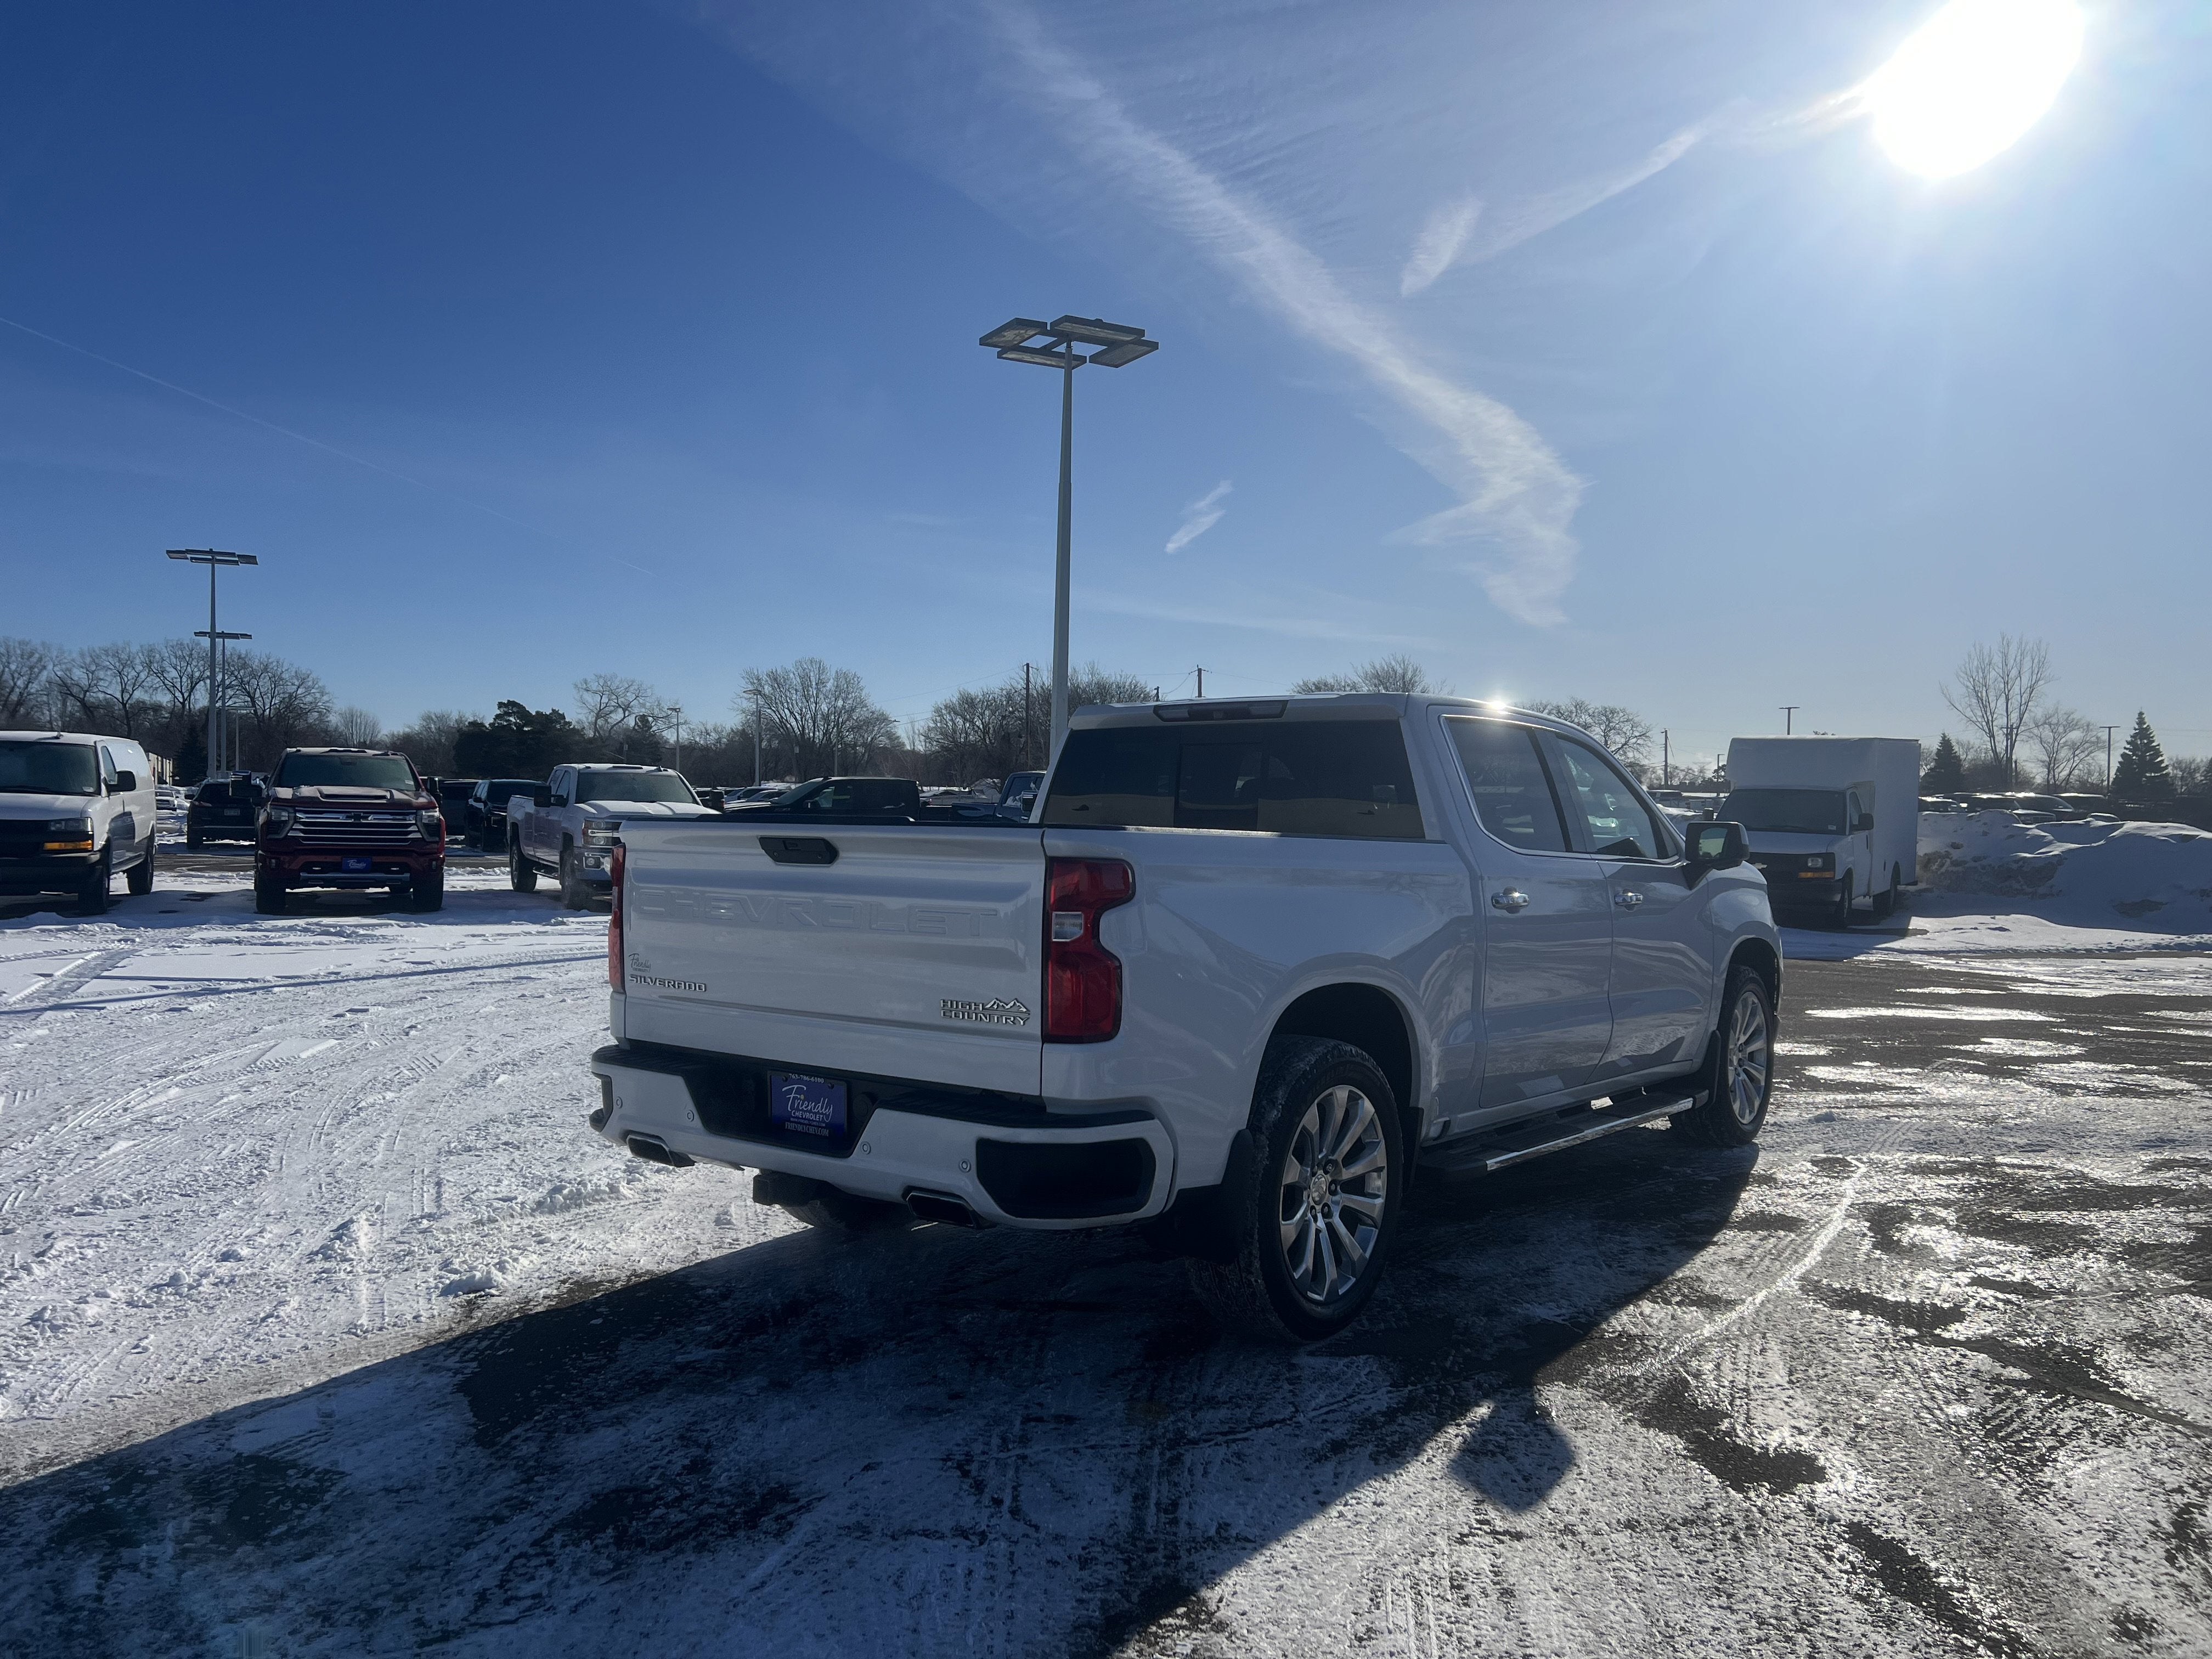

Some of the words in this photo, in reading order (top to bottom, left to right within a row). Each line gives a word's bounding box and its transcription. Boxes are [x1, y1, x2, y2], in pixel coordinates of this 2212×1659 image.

[638, 888, 1000, 936] CHEVROLET
[629, 974, 707, 992] SILVERADO
[940, 998, 984, 1011] HIGH
[940, 1009, 1030, 1026] COUNTRY
[789, 1073, 825, 1083] 763-786-6100
[782, 1085, 833, 1122] Friendly
[791, 1110, 823, 1121] CHEVROLET
[785, 1122, 830, 1137] FRIENDLYCHEV.COM
